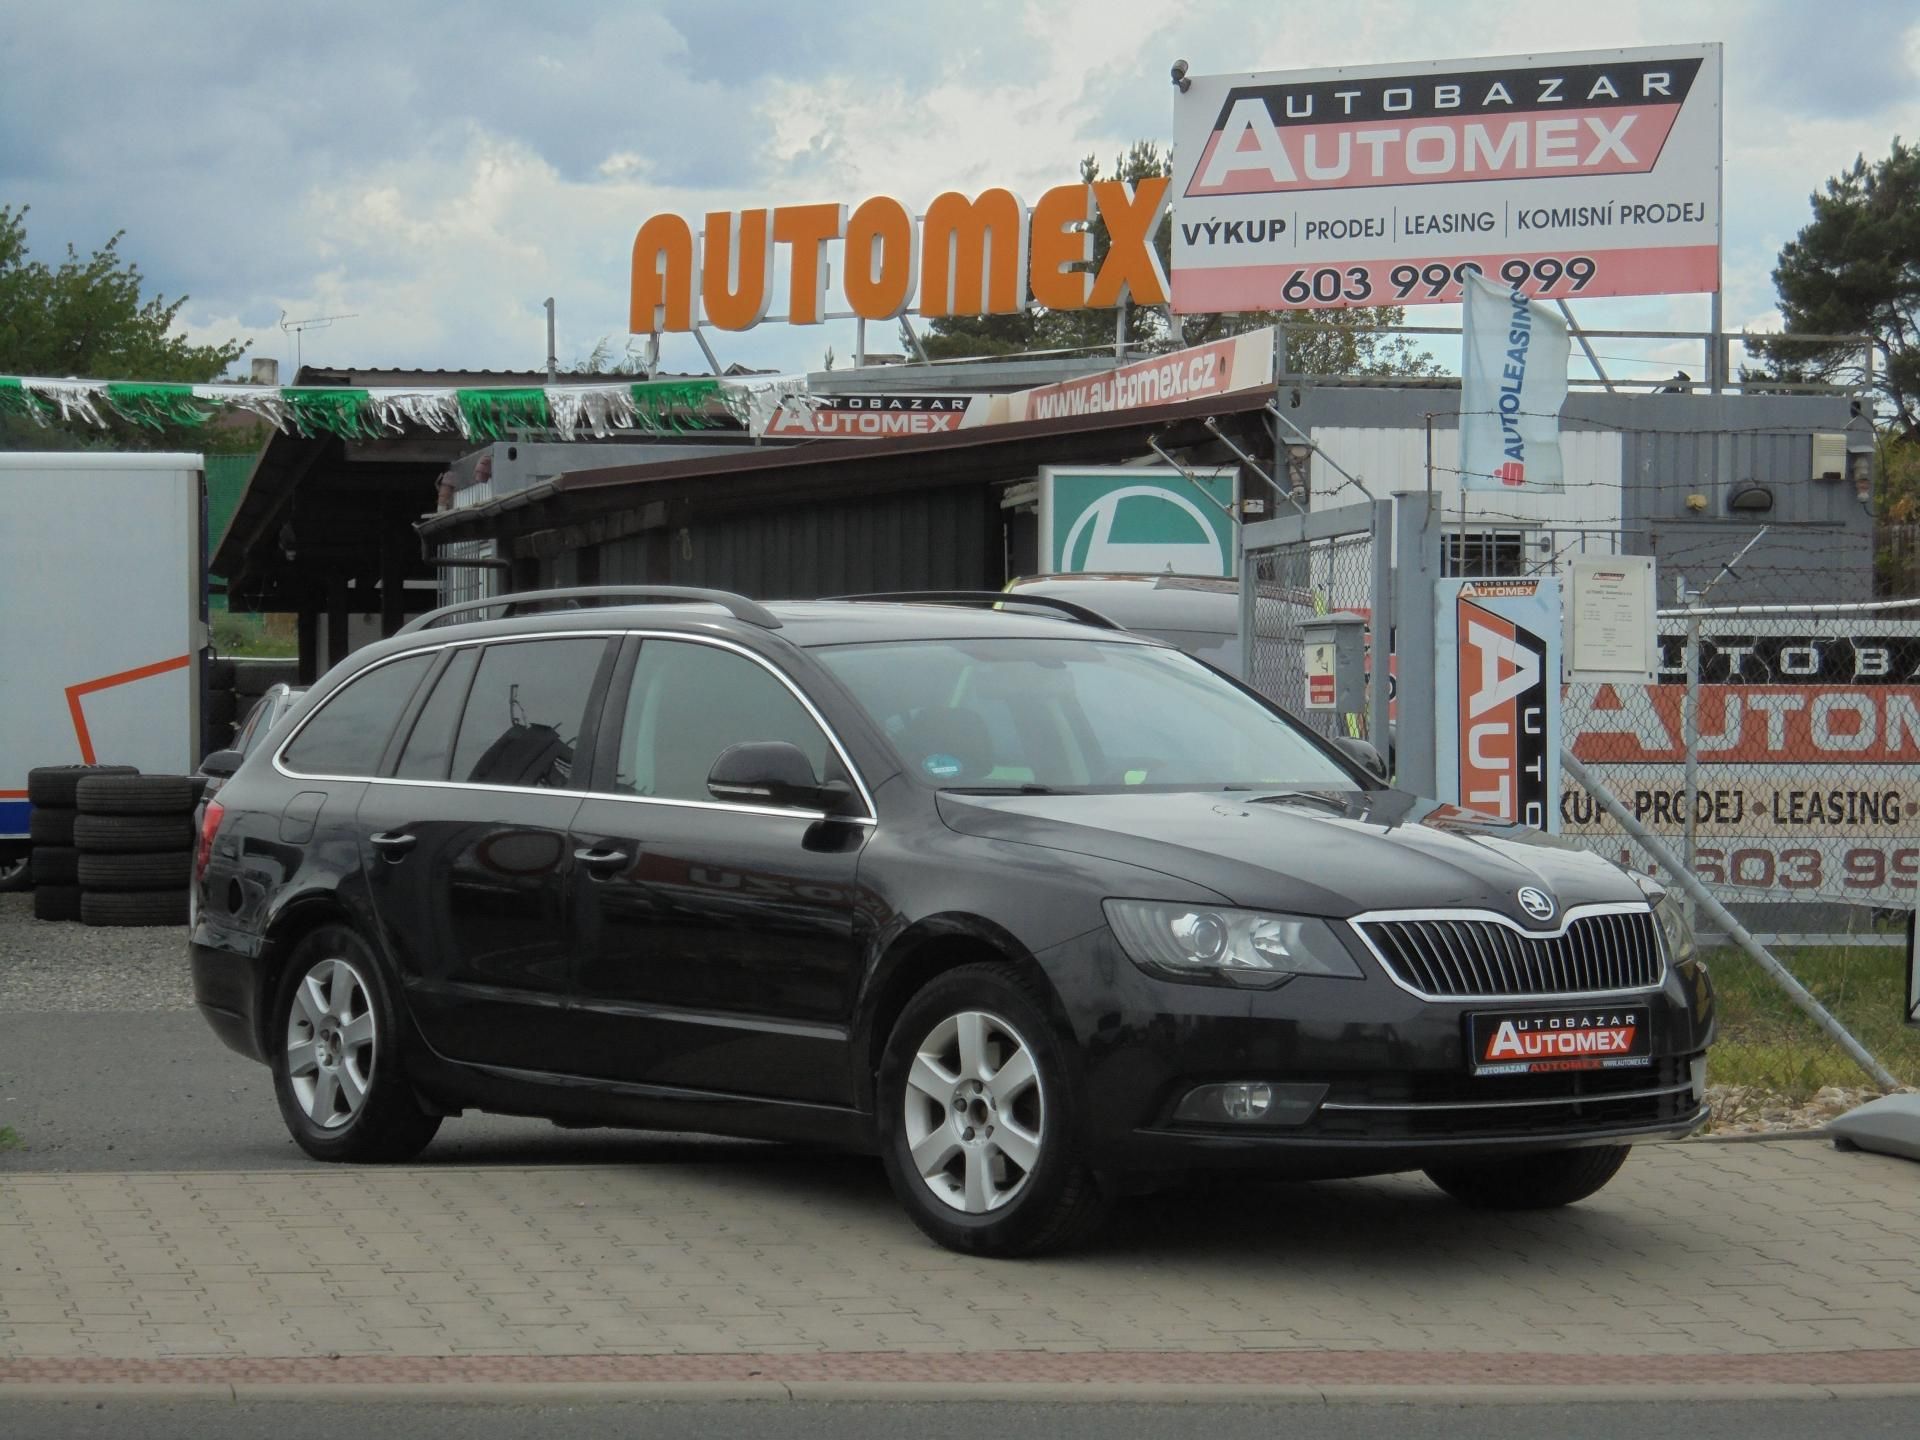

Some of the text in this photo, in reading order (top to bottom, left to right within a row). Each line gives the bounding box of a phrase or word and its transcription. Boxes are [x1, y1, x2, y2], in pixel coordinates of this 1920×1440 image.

[1199, 98, 1640, 188] AUTOMEX
[1182, 199, 1706, 247] VÝKUP PRODEJ LEASING KOMISNÍ PRODEJ
[629, 177, 1172, 334] AUTOMEX
[1281, 267, 1373, 304] 603
[1500, 256, 1597, 294] 999
[1036, 352, 1217, 419] www.automex.cz
[1498, 289, 1532, 462] AUTOLEASING
[773, 406, 952, 433] AUTOMEX
[1459, 582, 1533, 597] AUTOMEX
[1773, 790, 1901, 826] LEASING
[1491, 1021, 1627, 1057] AUTOMEX
[1475, 1064, 1528, 1076] AUTOBAZAR
[1530, 1060, 1599, 1073] AUTOMEX
